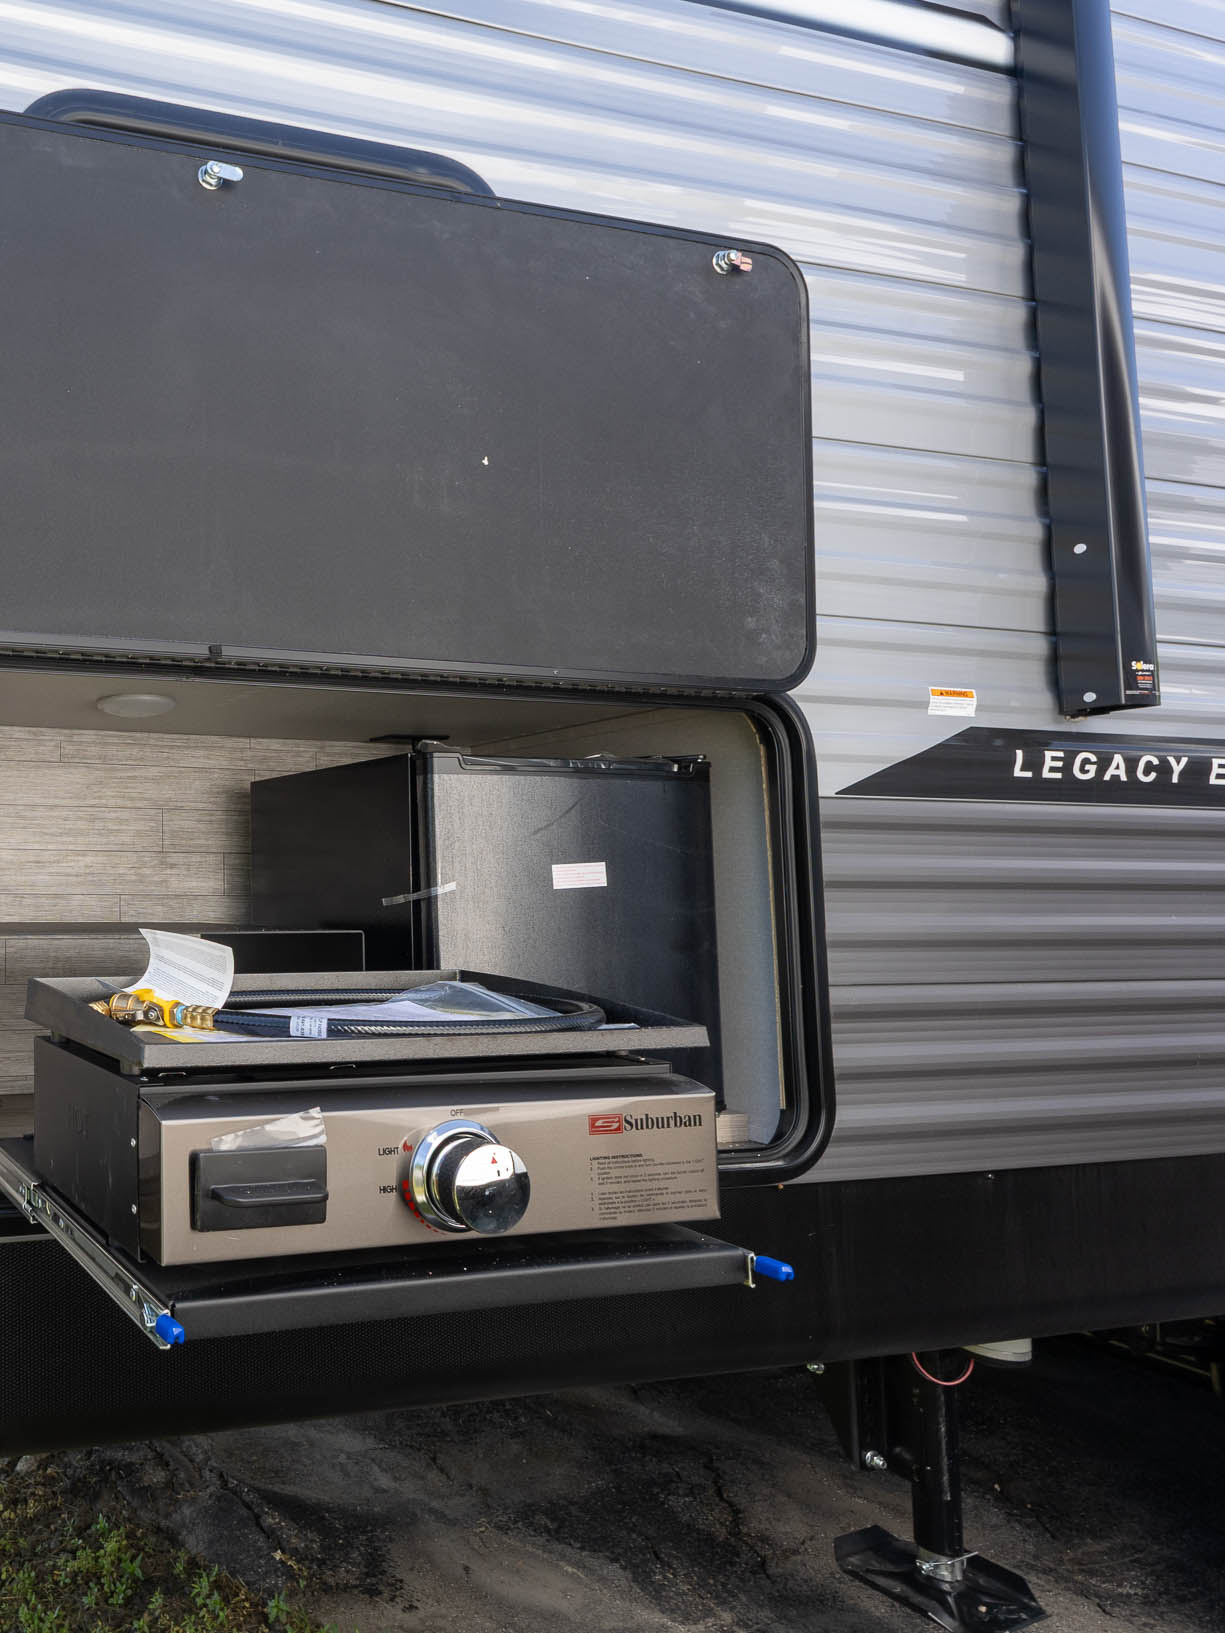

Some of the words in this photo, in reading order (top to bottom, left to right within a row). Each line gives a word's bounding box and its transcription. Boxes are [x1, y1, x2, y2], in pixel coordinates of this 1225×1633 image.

[1013, 750, 1189, 784] LEGACY
[1209, 758, 1225, 785] E
[450, 1109, 464, 1117] OFF
[623, 1112, 703, 1132] Suburban
[378, 1147, 400, 1156] LIGHT
[379, 1185, 397, 1194] HIGH
